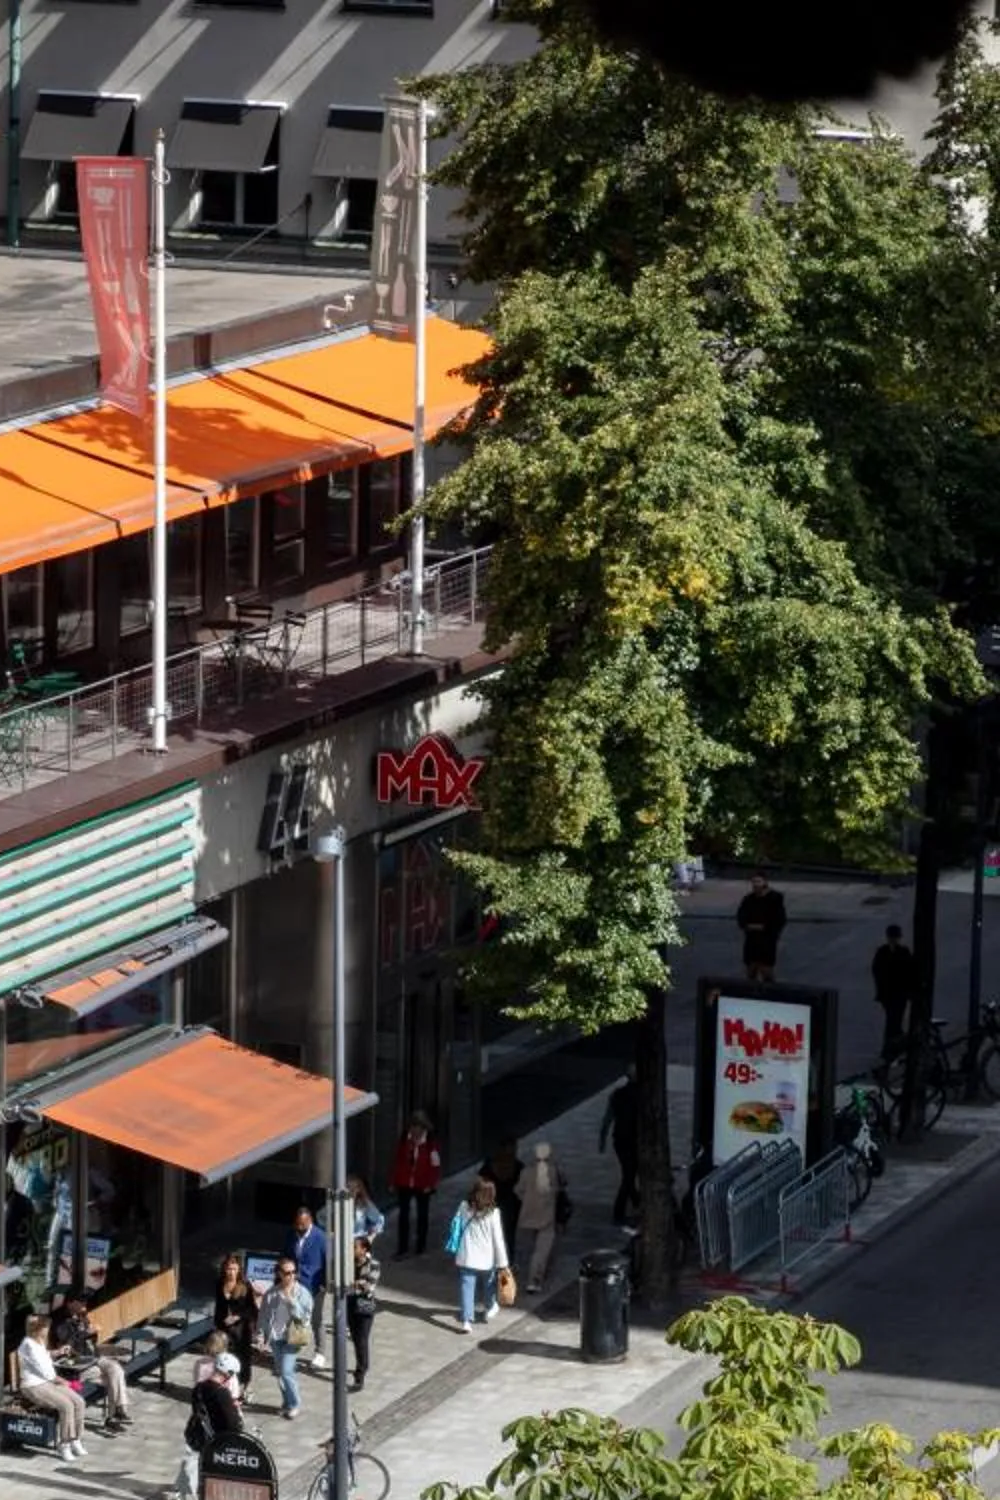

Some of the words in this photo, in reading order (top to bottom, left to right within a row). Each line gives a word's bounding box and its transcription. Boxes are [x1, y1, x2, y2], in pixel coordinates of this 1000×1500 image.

[378, 735, 484, 810] MAX
[724, 1061, 764, 1084] 49:-
[213, 1451, 260, 1469] NERO
